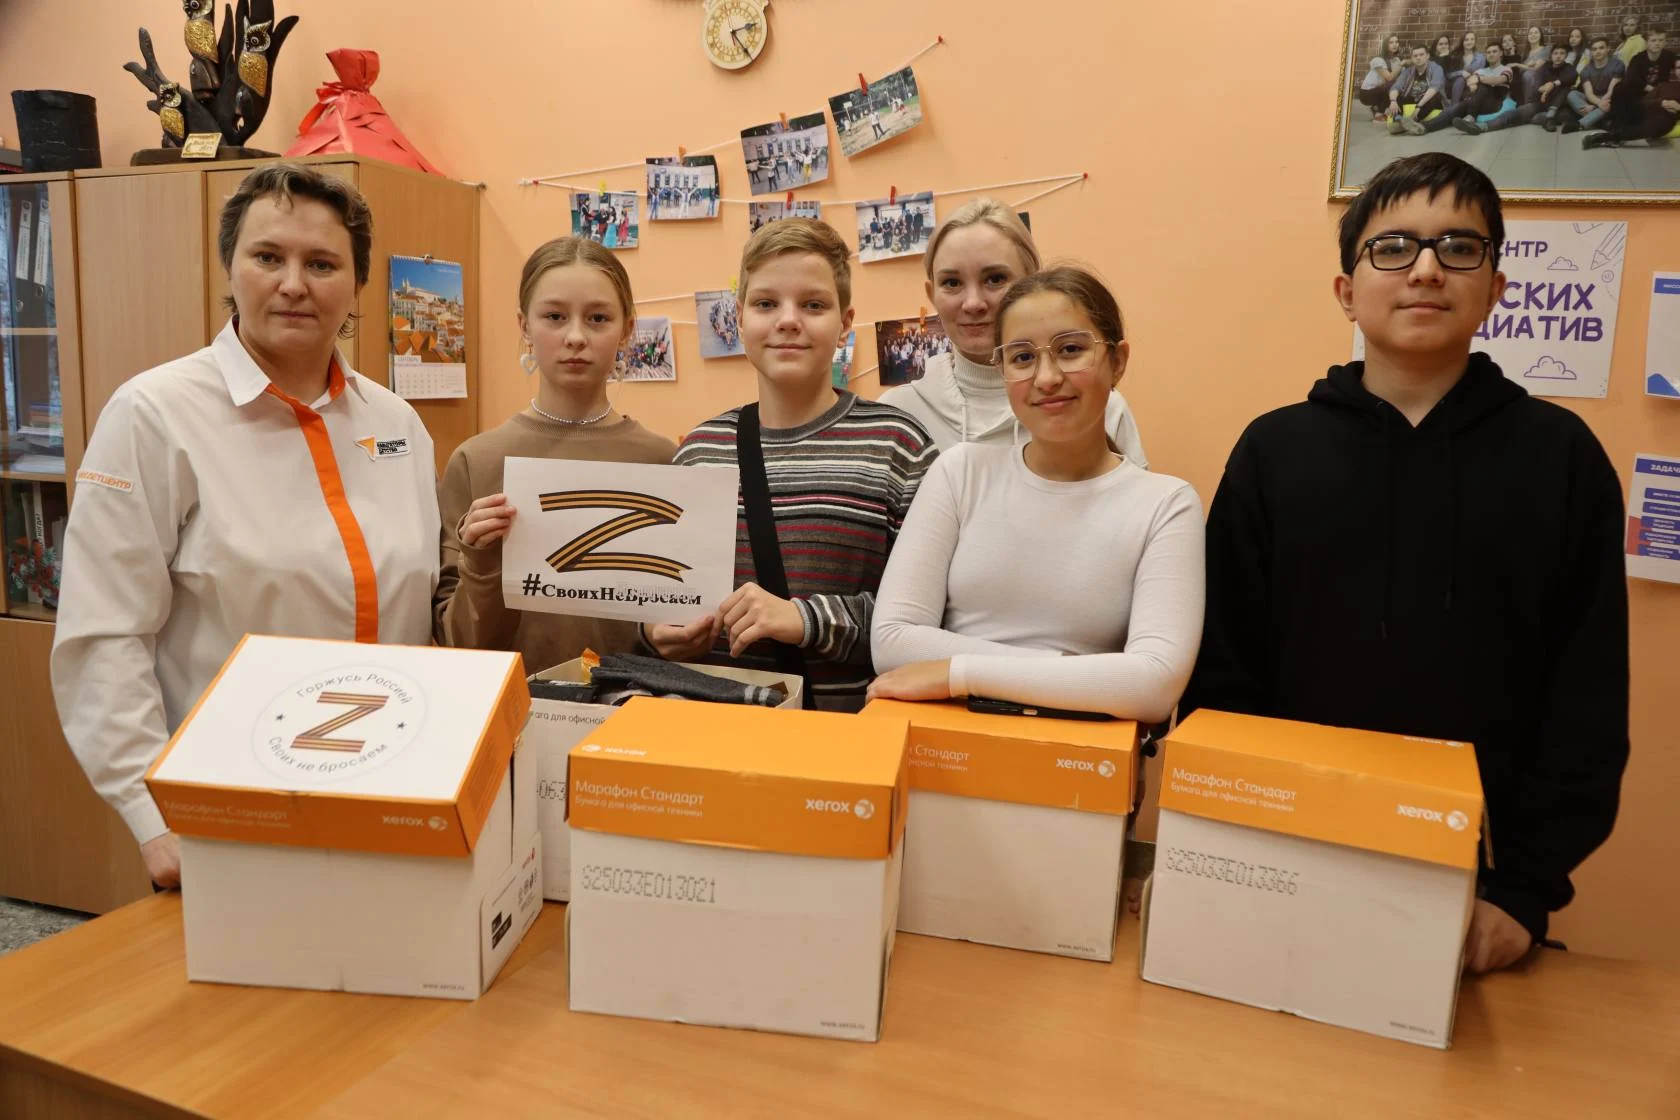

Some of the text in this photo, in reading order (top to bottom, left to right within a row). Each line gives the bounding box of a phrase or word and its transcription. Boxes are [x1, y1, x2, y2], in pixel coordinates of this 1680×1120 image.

[1500, 240, 1549, 258] НТР
[1499, 281, 1596, 312] СКИХ
[522, 572, 702, 607] #СвоихНеБросаем
[296, 673, 415, 705] Горжусь Россией
[550, 711, 567, 722] для
[268, 736, 389, 774] Своих не бросаем
[915, 744, 970, 763] Стандарт
[1055, 758, 1095, 772] xerox
[575, 780, 704, 806] Марафон Стандарт
[1172, 767, 1297, 802] Марафон Стандарт
[805, 798, 851, 814] xerox
[1396, 803, 1443, 823] xerox
[382, 814, 425, 827] xerox
[581, 863, 717, 904] S25033E013021
[1166, 847, 1300, 897] S25033E013366
